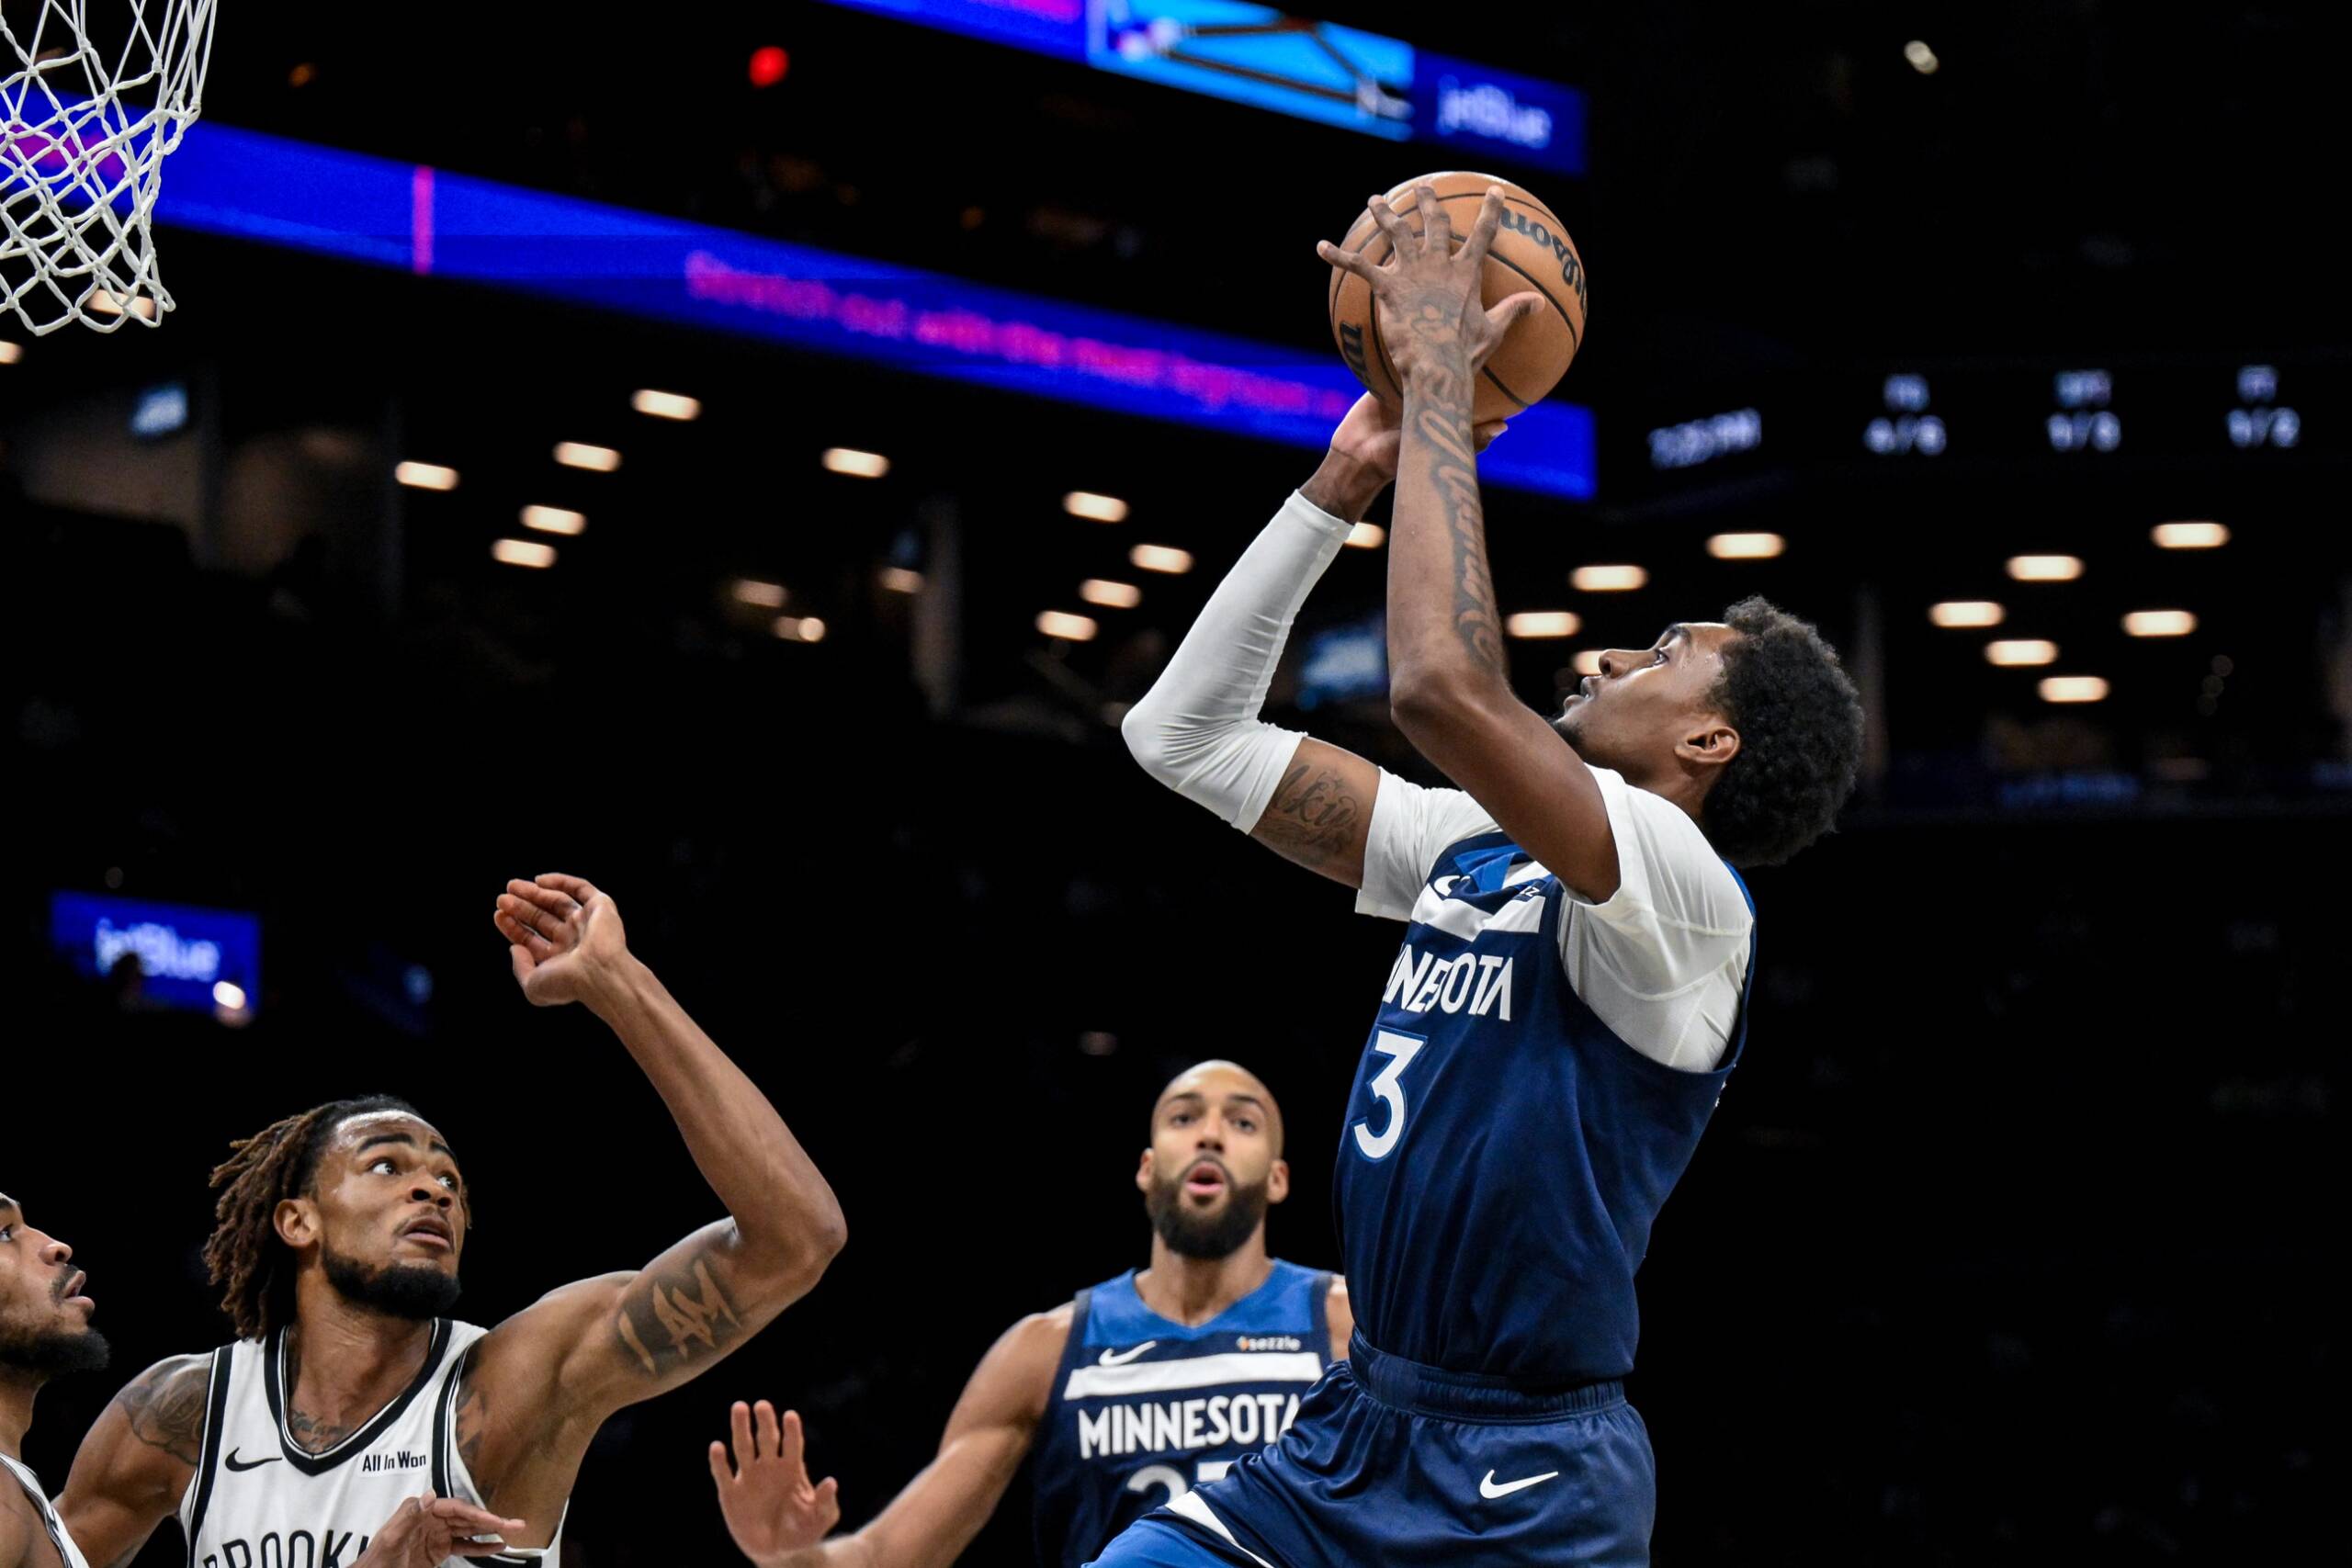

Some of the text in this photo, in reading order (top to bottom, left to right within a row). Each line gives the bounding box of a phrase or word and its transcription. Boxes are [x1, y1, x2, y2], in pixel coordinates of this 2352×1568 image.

[1353, 1030, 1424, 1158] 3
[362, 1450, 426, 1472] All In Won
